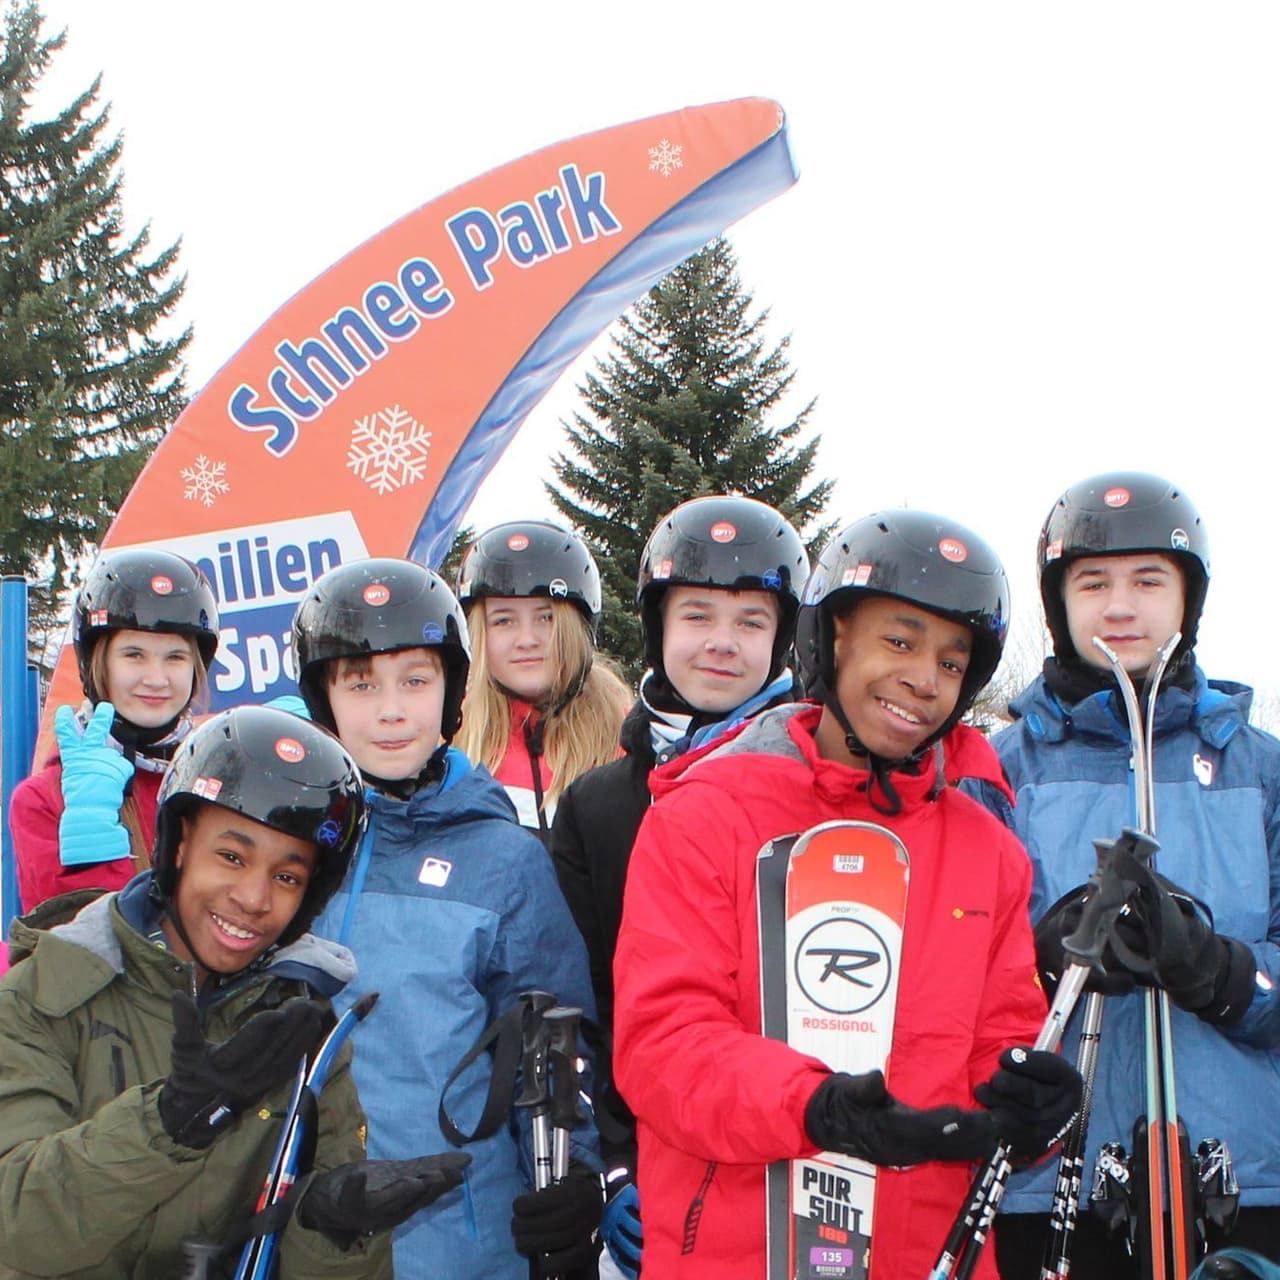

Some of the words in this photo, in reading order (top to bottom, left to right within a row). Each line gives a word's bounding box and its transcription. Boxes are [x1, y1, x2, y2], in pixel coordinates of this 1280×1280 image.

[230, 254, 455, 456] Schnee
[448, 166, 620, 288] Park
[802, 1017, 877, 1034] ROSSIGNOL
[802, 1166, 851, 1203] PUR
[809, 1195, 863, 1234] SUIT
[821, 1251, 842, 1262] 135
